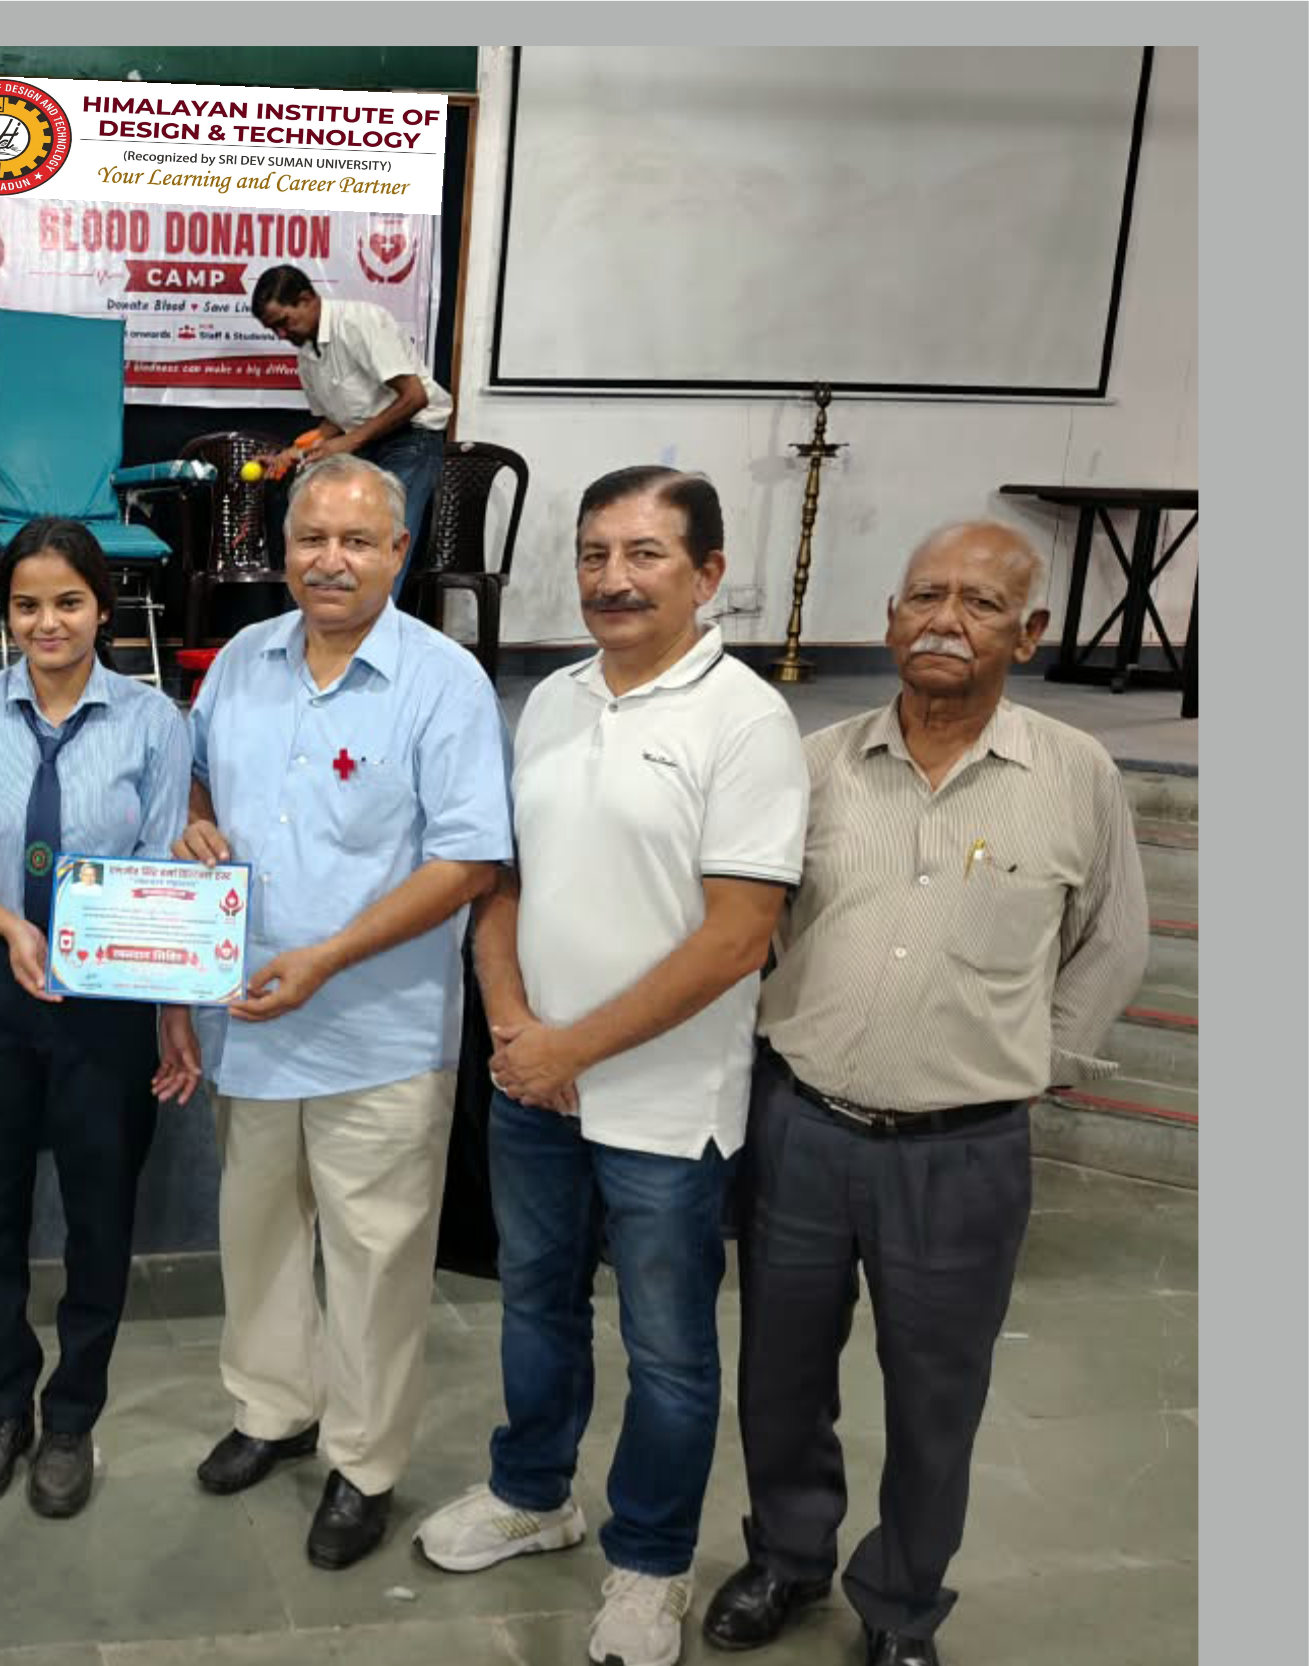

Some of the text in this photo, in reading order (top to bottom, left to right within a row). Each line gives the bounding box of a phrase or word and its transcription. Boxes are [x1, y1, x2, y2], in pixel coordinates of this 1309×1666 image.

[38, 207, 331, 259] BLOOD DONATION
[146, 267, 227, 288] CAMP
[235, 302, 252, 313] Liv
